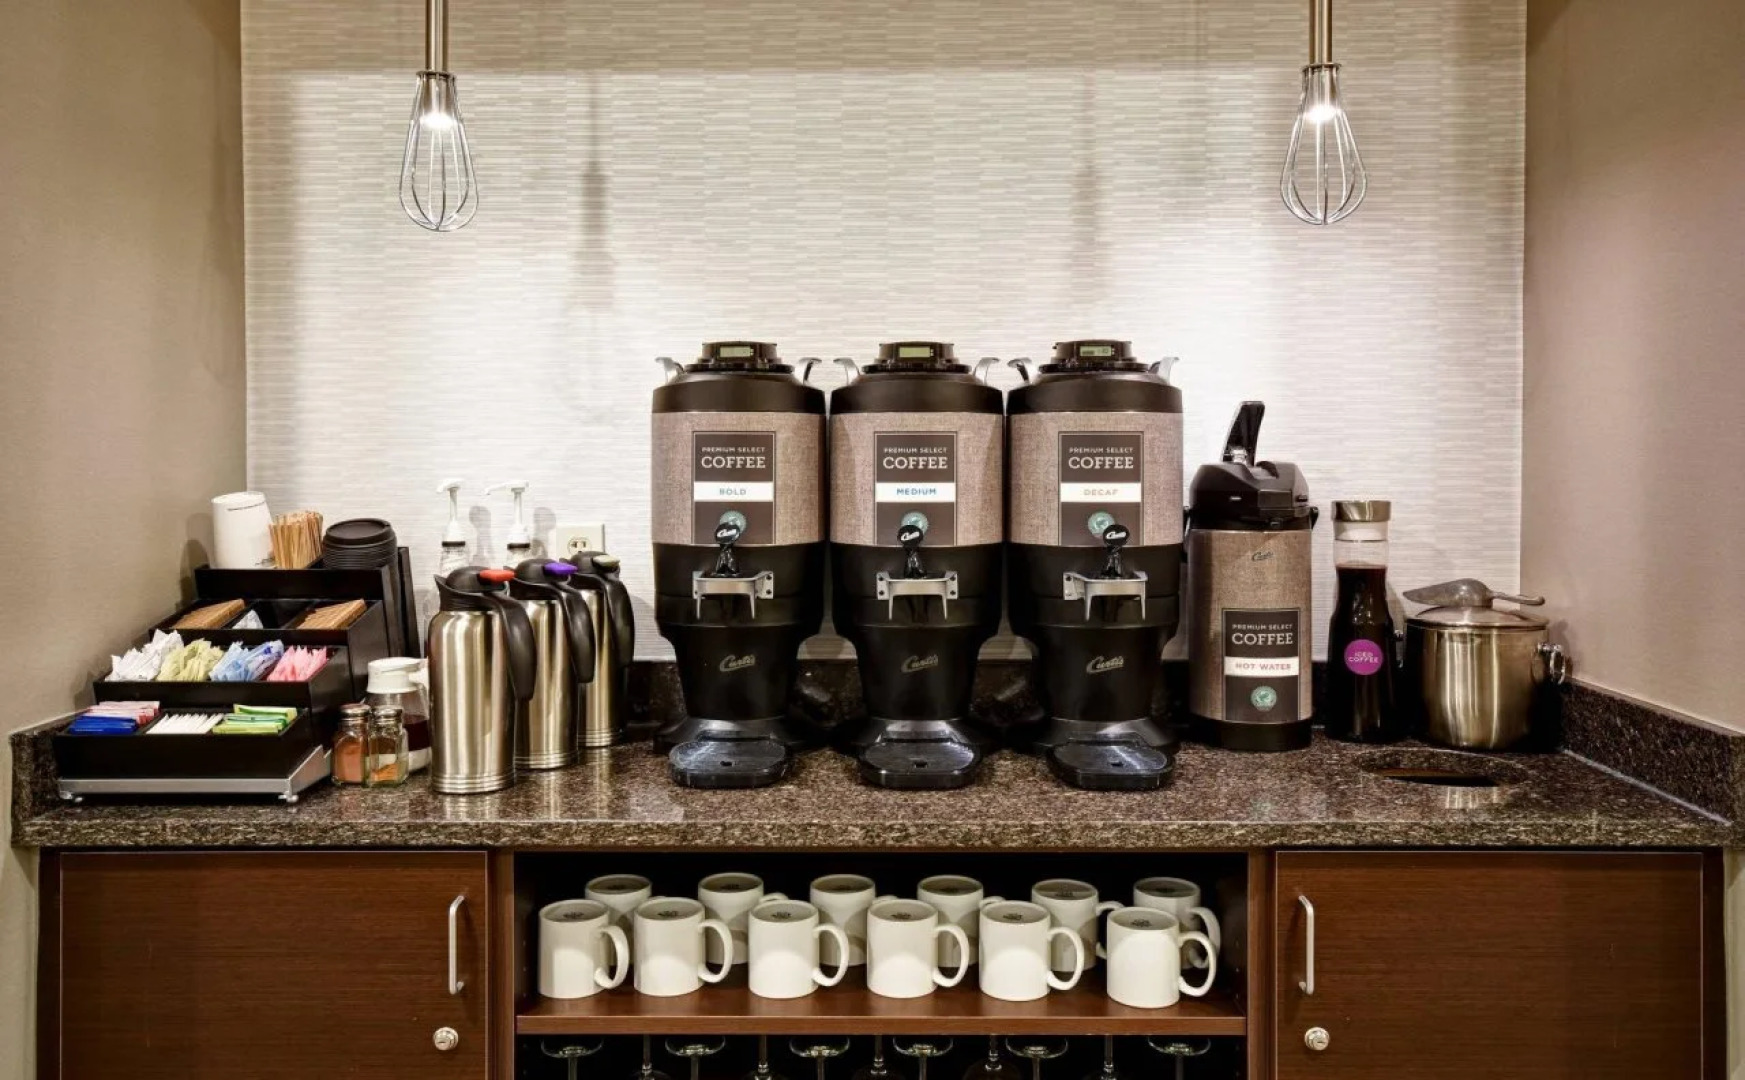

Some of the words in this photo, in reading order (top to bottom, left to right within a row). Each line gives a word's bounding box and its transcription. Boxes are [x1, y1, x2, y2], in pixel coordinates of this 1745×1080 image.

[701, 456, 766, 469] COFFEE
[883, 456, 948, 469] COFFEE
[1068, 456, 1134, 469] COFFEE
[1232, 623, 1267, 631] PREMIUM
[1269, 623, 1293, 631] SELECT
[1231, 633, 1293, 645] COFFEE
[1235, 663, 1256, 671] HOT
[1259, 663, 1292, 671] WATER
